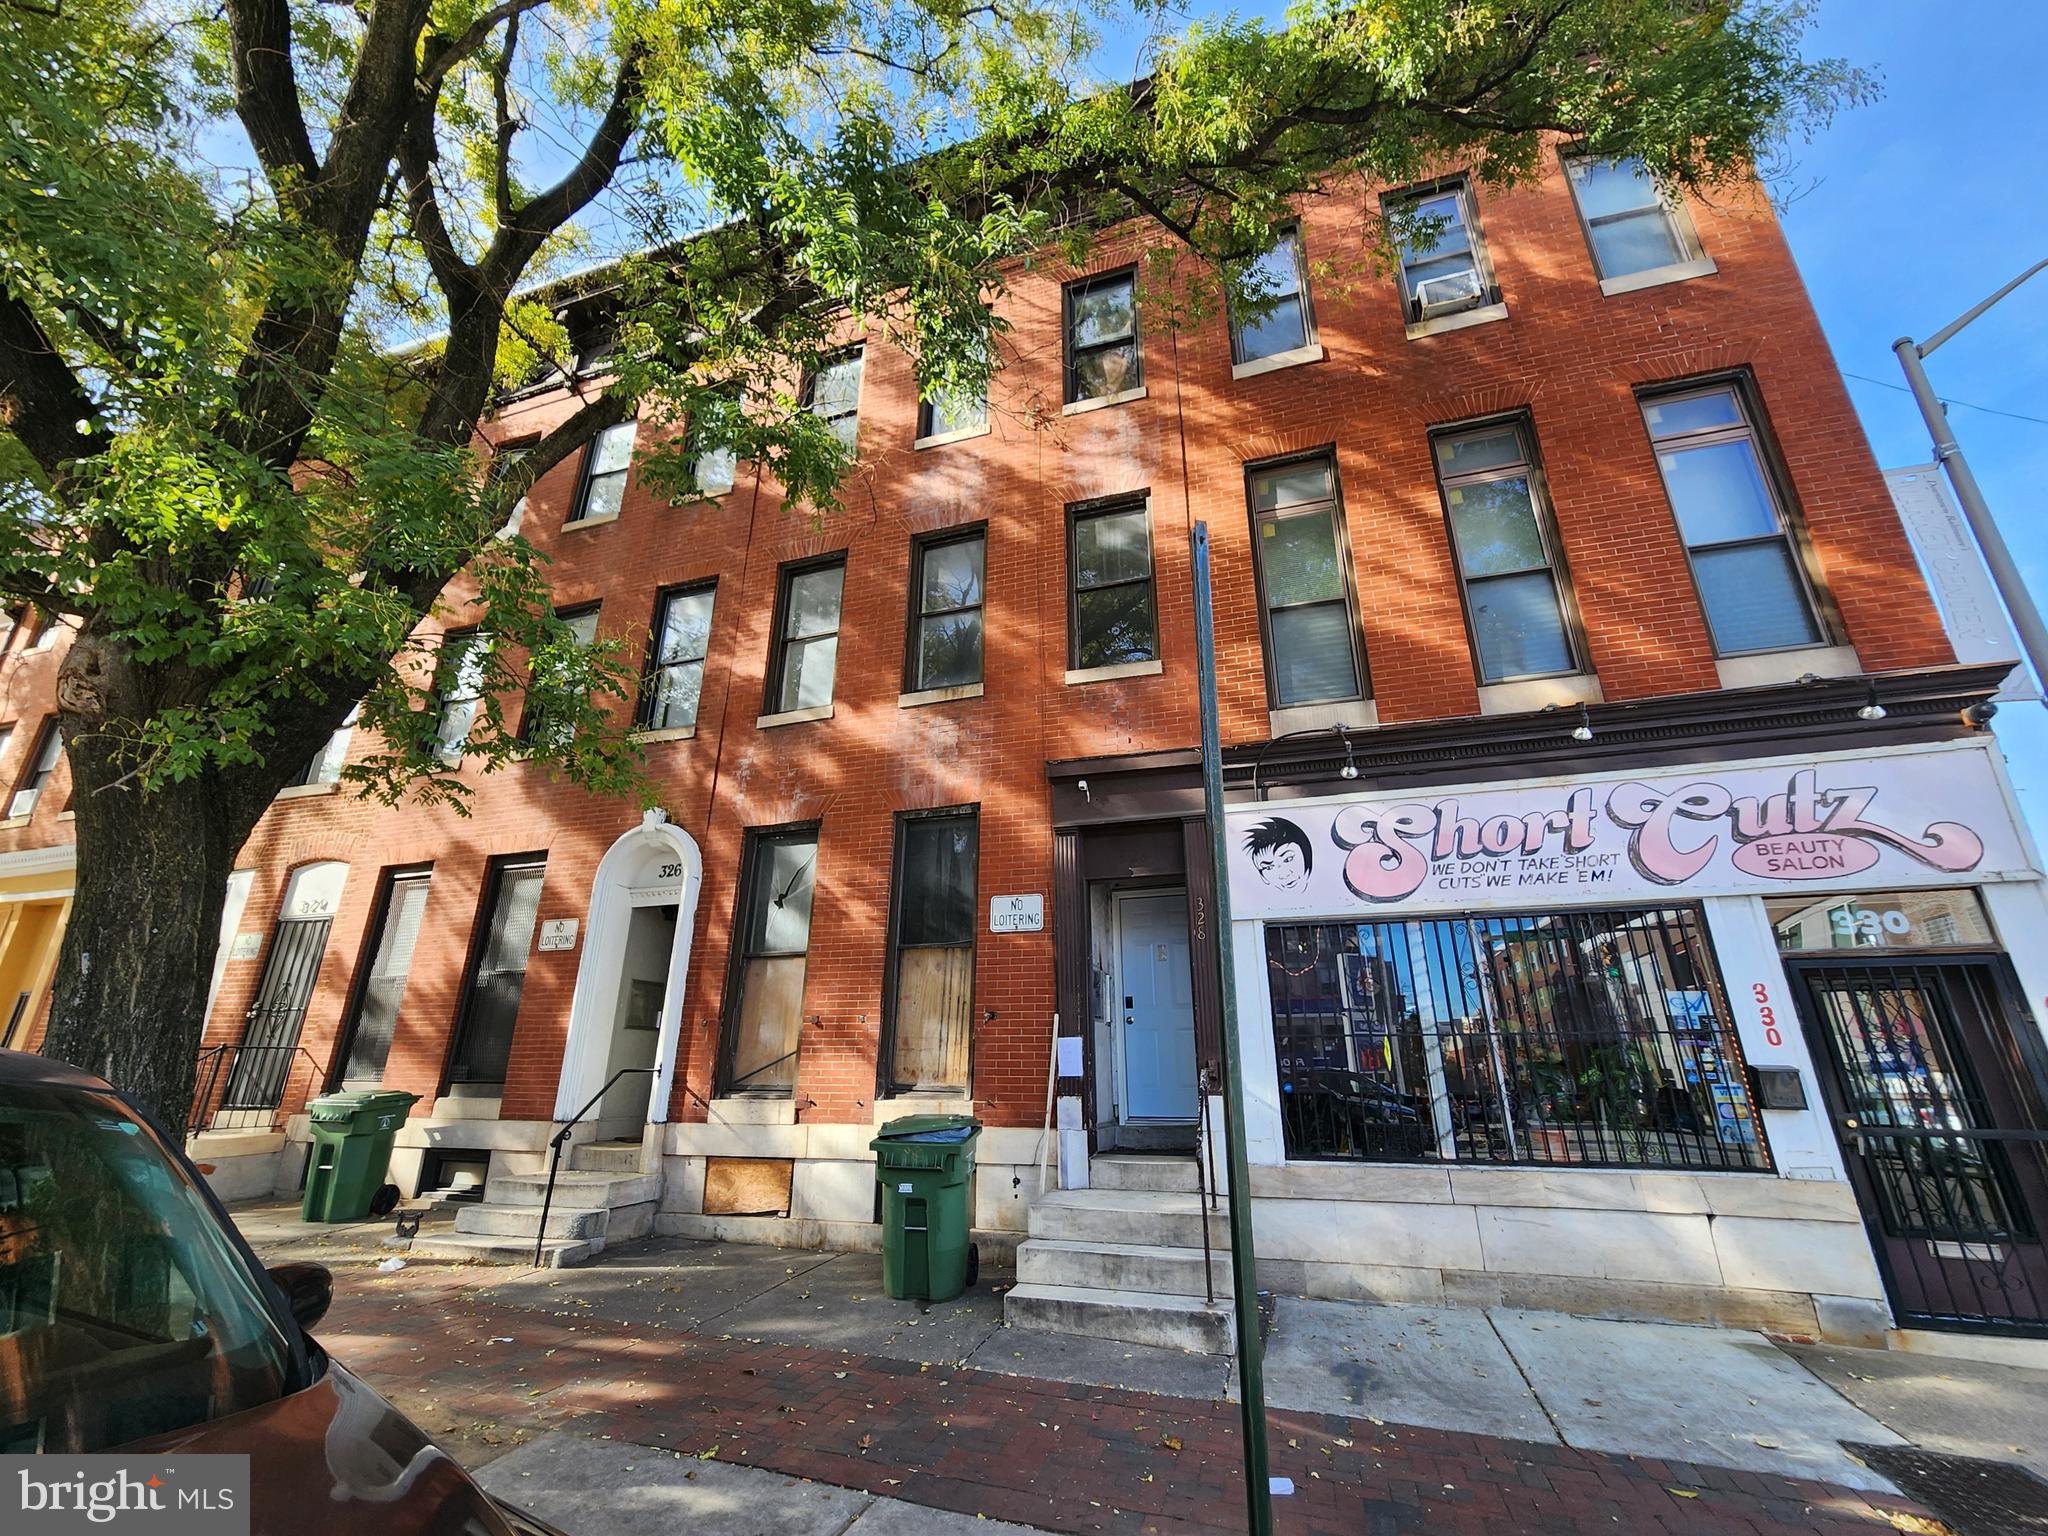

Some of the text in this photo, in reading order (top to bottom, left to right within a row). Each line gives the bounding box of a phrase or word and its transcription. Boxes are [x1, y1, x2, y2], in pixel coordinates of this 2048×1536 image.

[1331, 768, 1984, 903] Short Cutz
[1756, 838, 1845, 856] BEAUTY
[658, 863, 682, 879] 326
[1432, 863, 1456, 876] WE
[1460, 858, 1511, 874] DON'T
[1518, 856, 1560, 871] TAKE
[1767, 855, 1845, 872] SALON
[1486, 875, 1512, 887] WE
[1518, 871, 1568, 886] MAKE
[1576, 868, 1613, 884] 'EM!
[301, 899, 329, 914] 324
[1010, 899, 1024, 911] NO
[555, 922, 565, 933] NO
[993, 913, 1040, 927] LOITERING
[1831, 909, 1911, 935] 330
[541, 934, 575, 946] LOITERING
[1752, 982, 1782, 1046] 330
